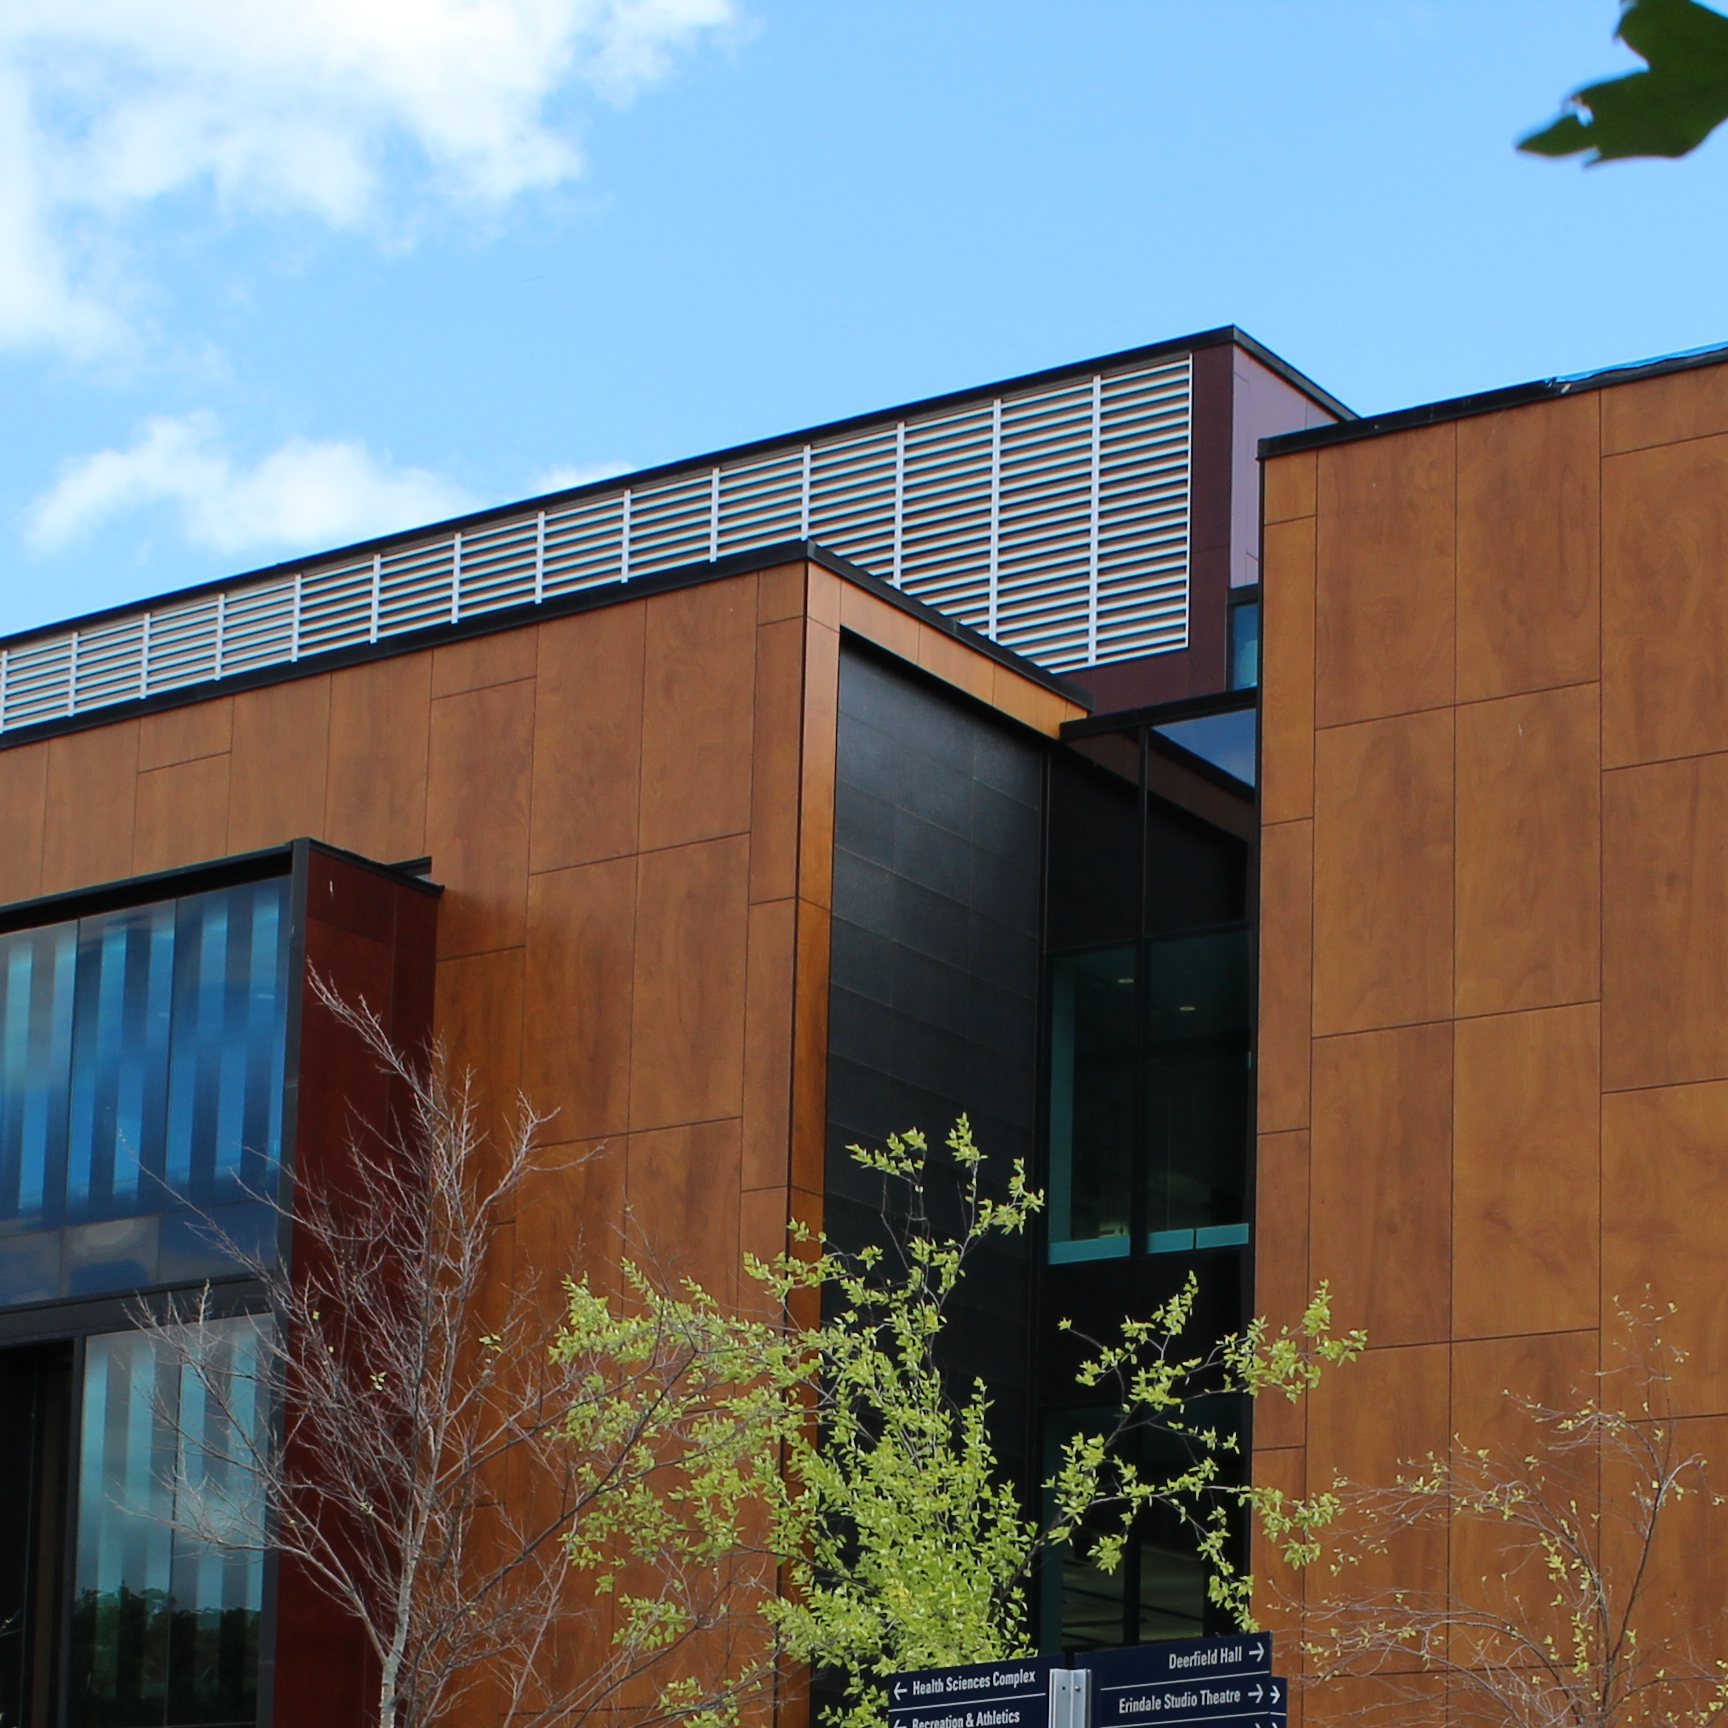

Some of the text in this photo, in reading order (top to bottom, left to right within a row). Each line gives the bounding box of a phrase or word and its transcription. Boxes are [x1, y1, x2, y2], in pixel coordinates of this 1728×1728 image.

[1168, 1645, 1243, 1670] Deerfield Hall
[912, 1668, 1036, 1696] Health Sciences Complex
[1118, 1689, 1241, 1714] Erindale Studio Theatre
[965, 1712, 974, 1728] &
[976, 1708, 1020, 1727] Athletics
